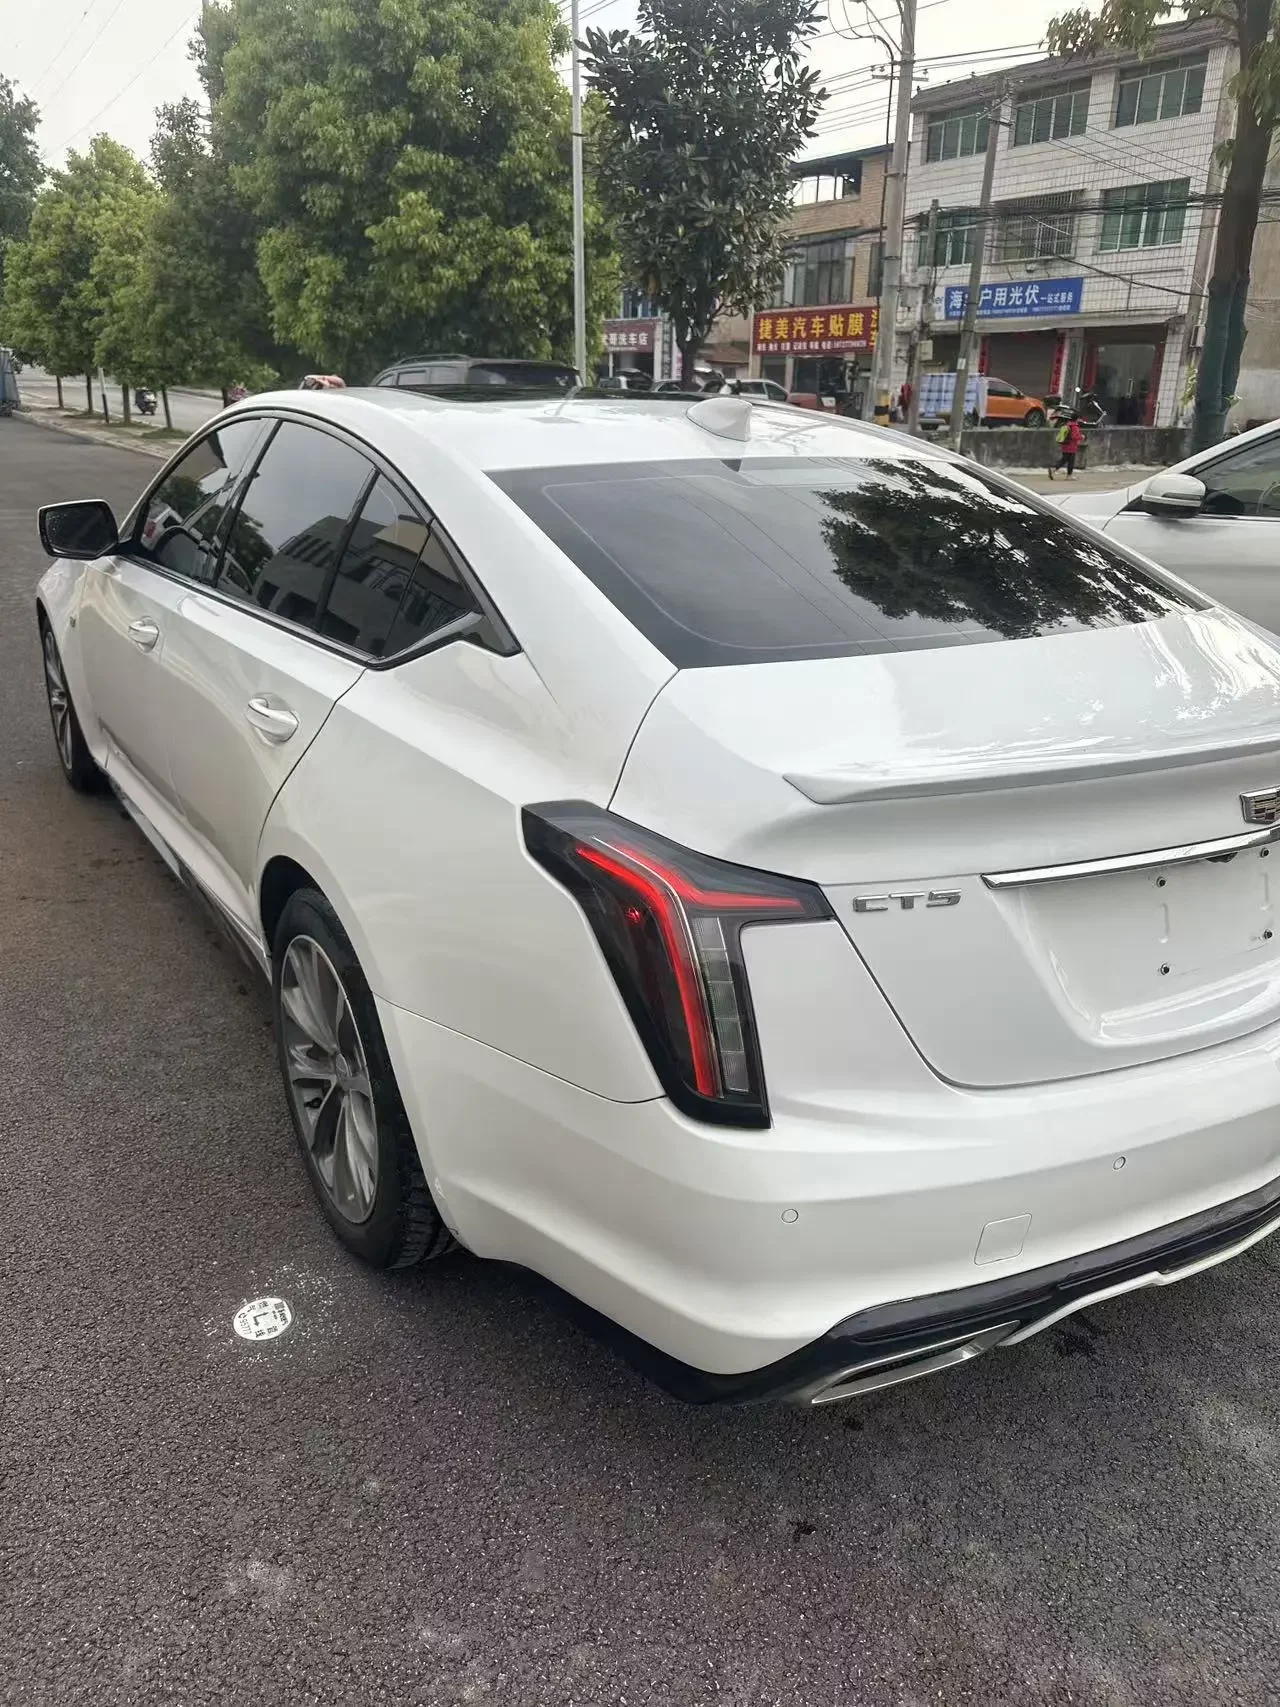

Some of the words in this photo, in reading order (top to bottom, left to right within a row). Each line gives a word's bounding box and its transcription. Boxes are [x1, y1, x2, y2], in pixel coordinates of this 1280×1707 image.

[949, 285, 1040, 309] 海户用光伏
[759, 312, 865, 340] 捷美汽车贴膜
